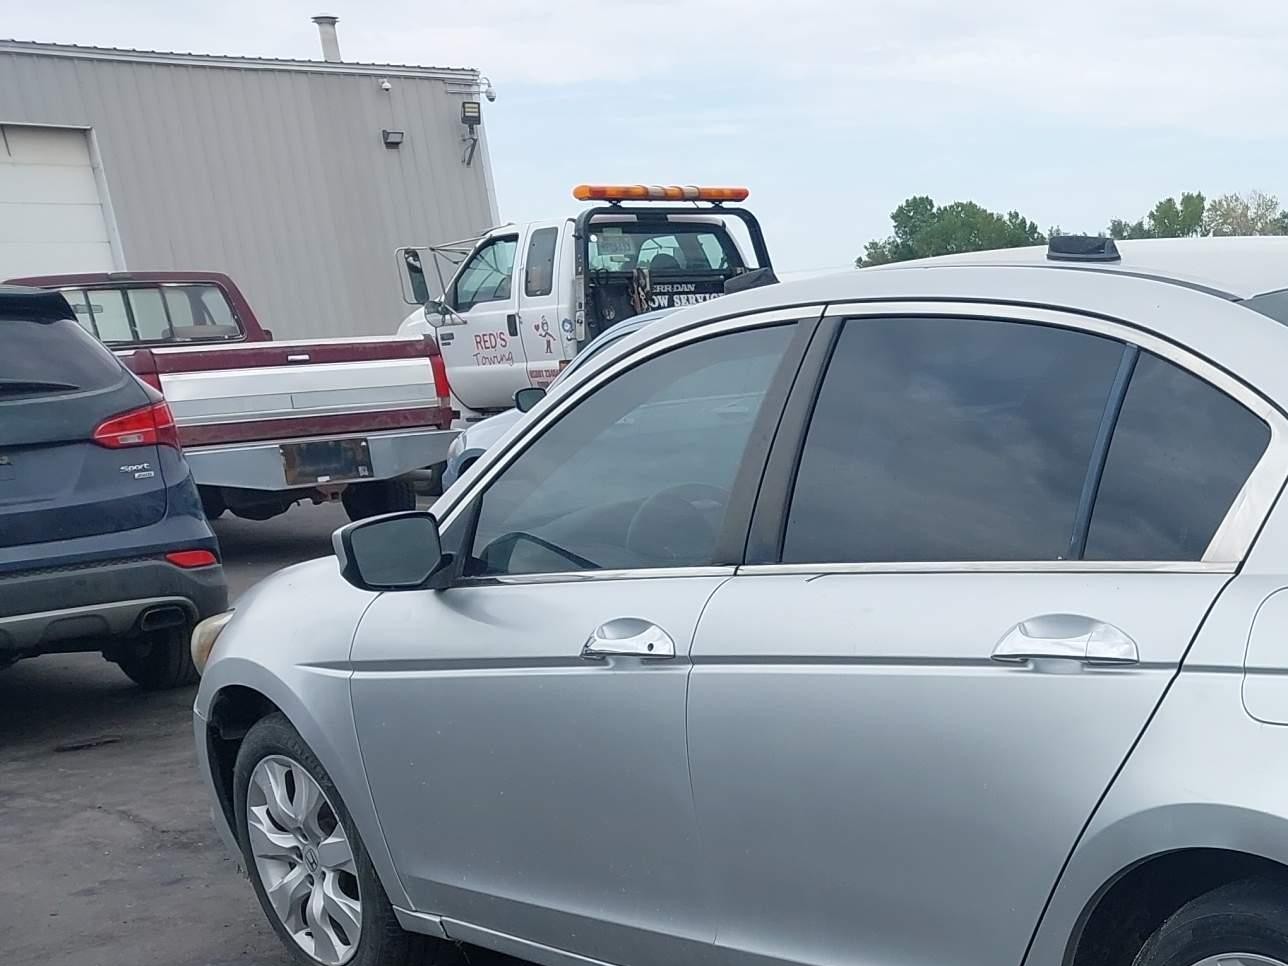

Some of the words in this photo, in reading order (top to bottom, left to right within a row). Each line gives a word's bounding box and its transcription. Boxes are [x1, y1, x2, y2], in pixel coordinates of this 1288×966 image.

[649, 295, 669, 308] OW
[474, 332, 508, 350] RED'S
[473, 352, 513, 367] Towing
[120, 463, 151, 472] Sport
